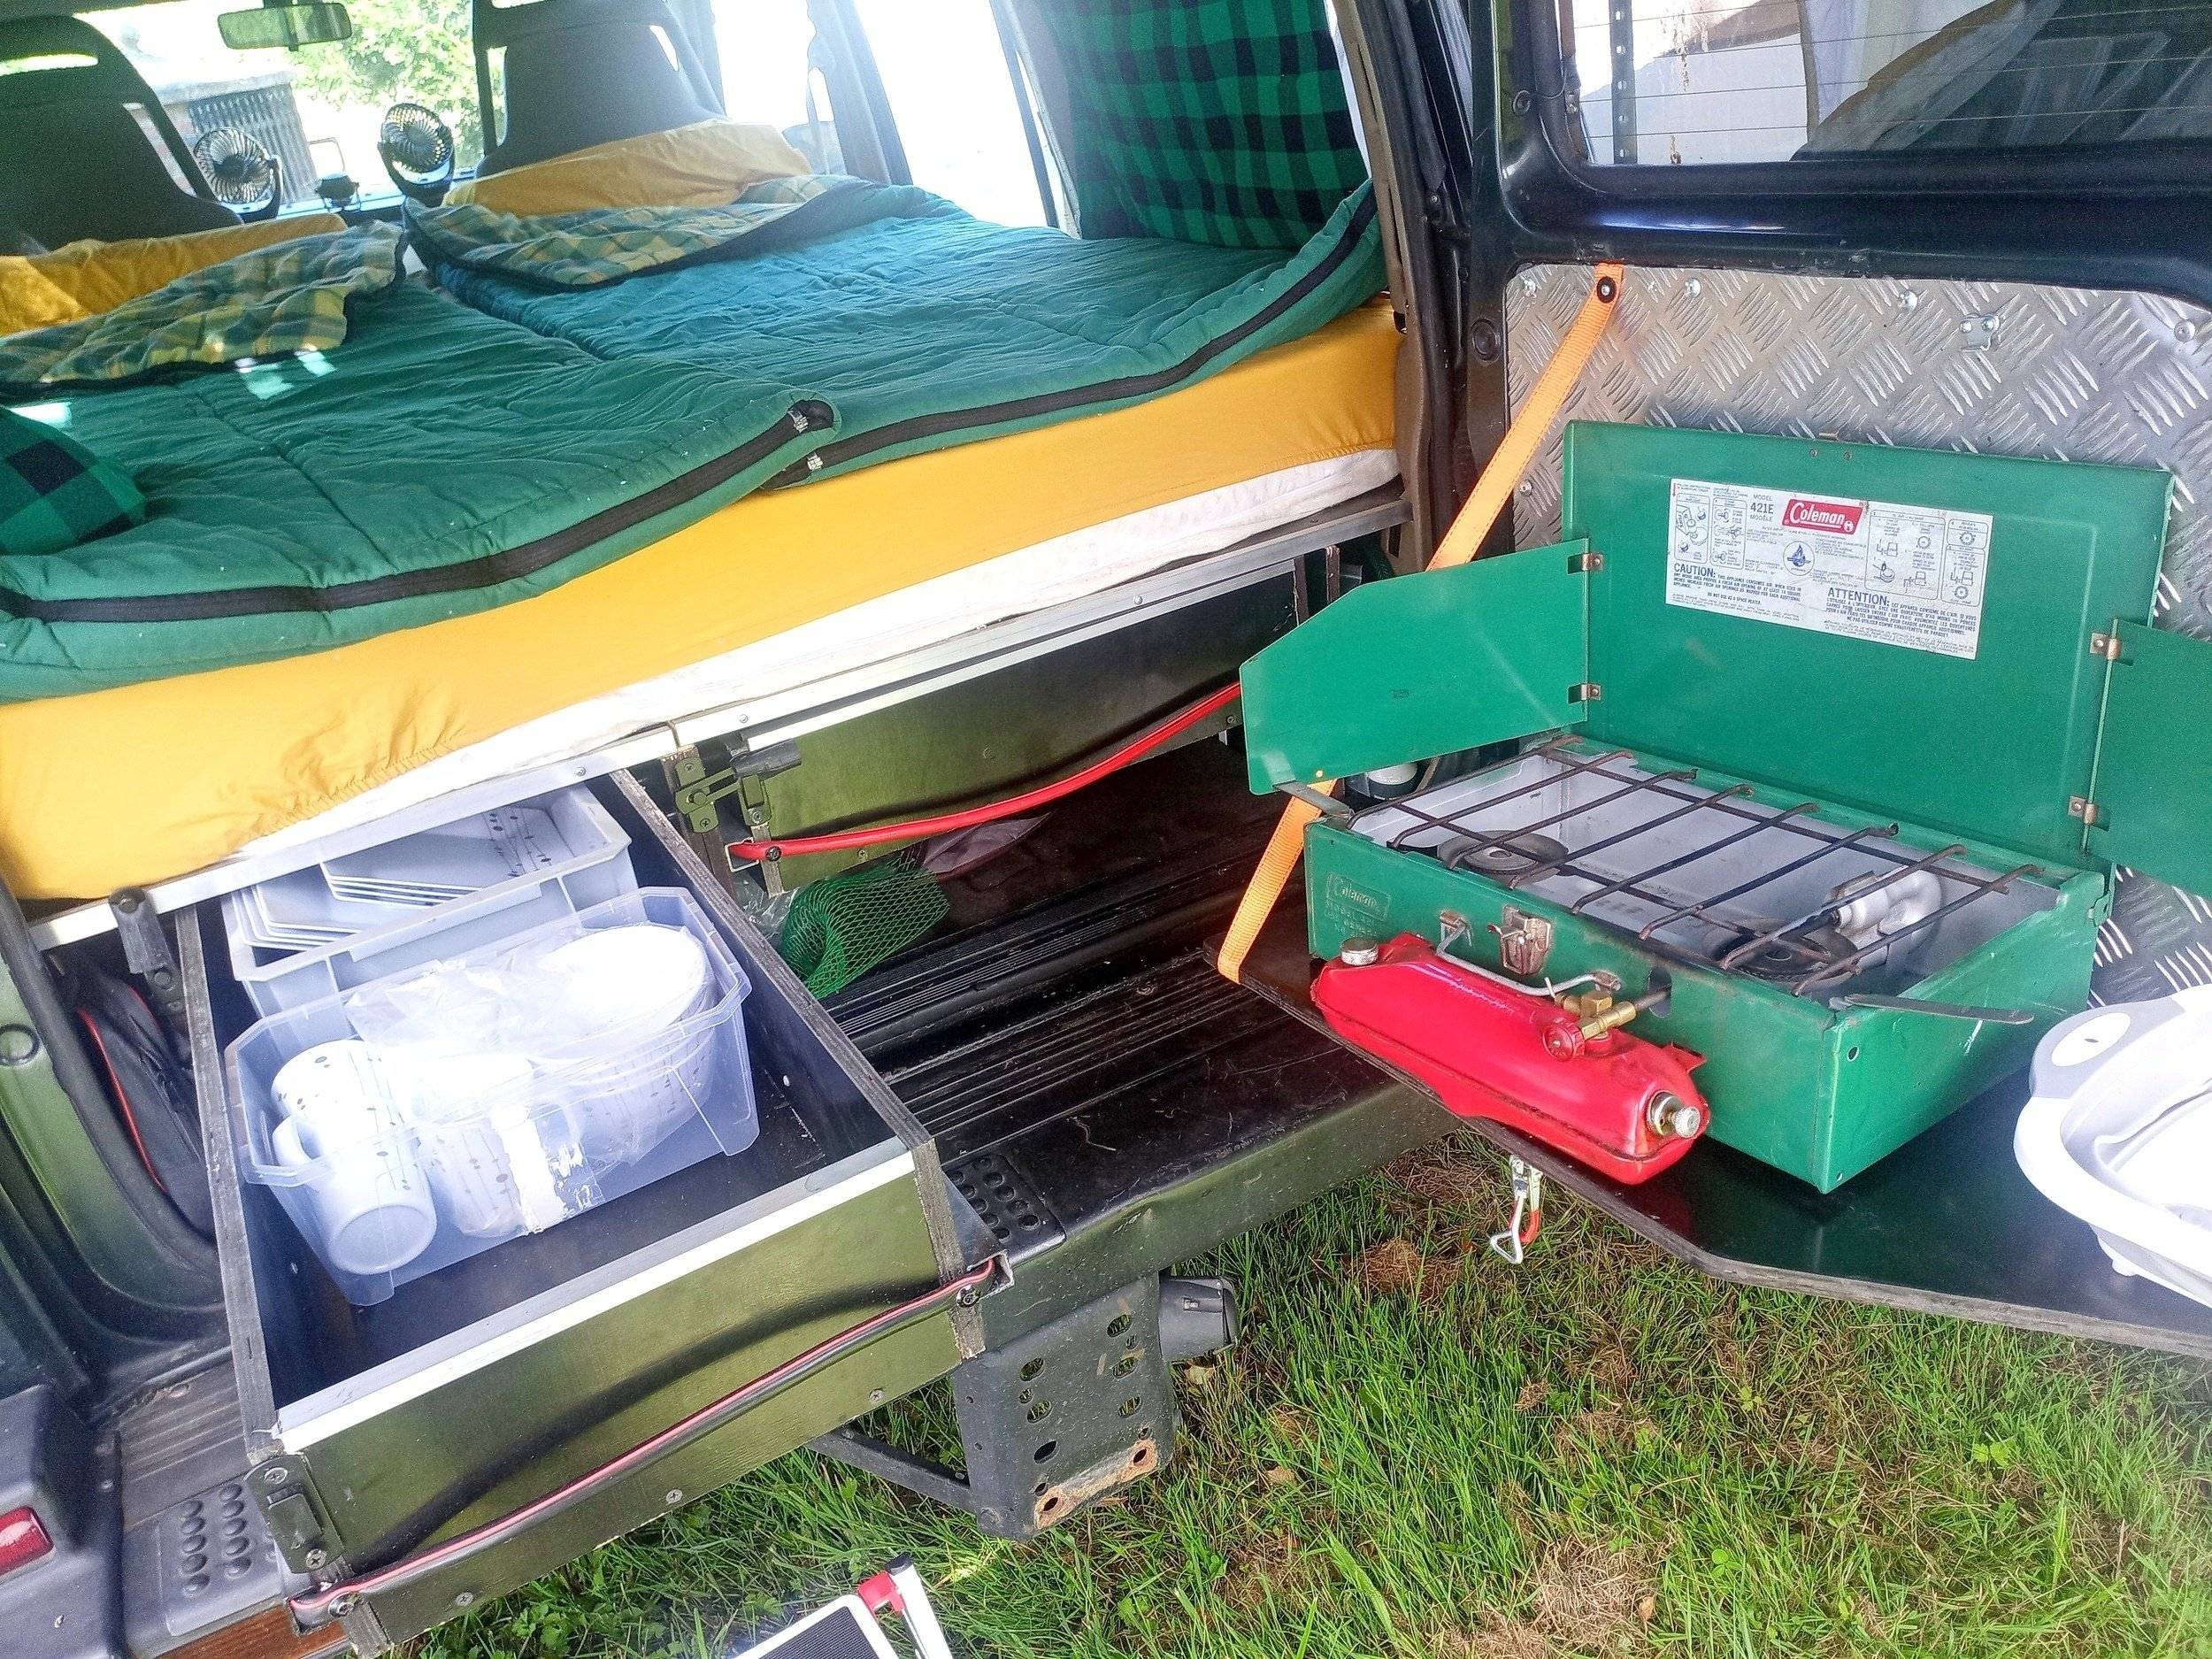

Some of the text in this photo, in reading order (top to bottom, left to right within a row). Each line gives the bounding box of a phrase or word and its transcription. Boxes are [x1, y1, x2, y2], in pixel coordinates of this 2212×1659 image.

[1750, 503, 1774, 514] 421E
[1789, 502, 1846, 525] Coleman
[1673, 563, 1716, 578] CAUTION:
[1827, 587, 1890, 606] ATTENTION:
[1333, 878, 1378, 907] Coleman
